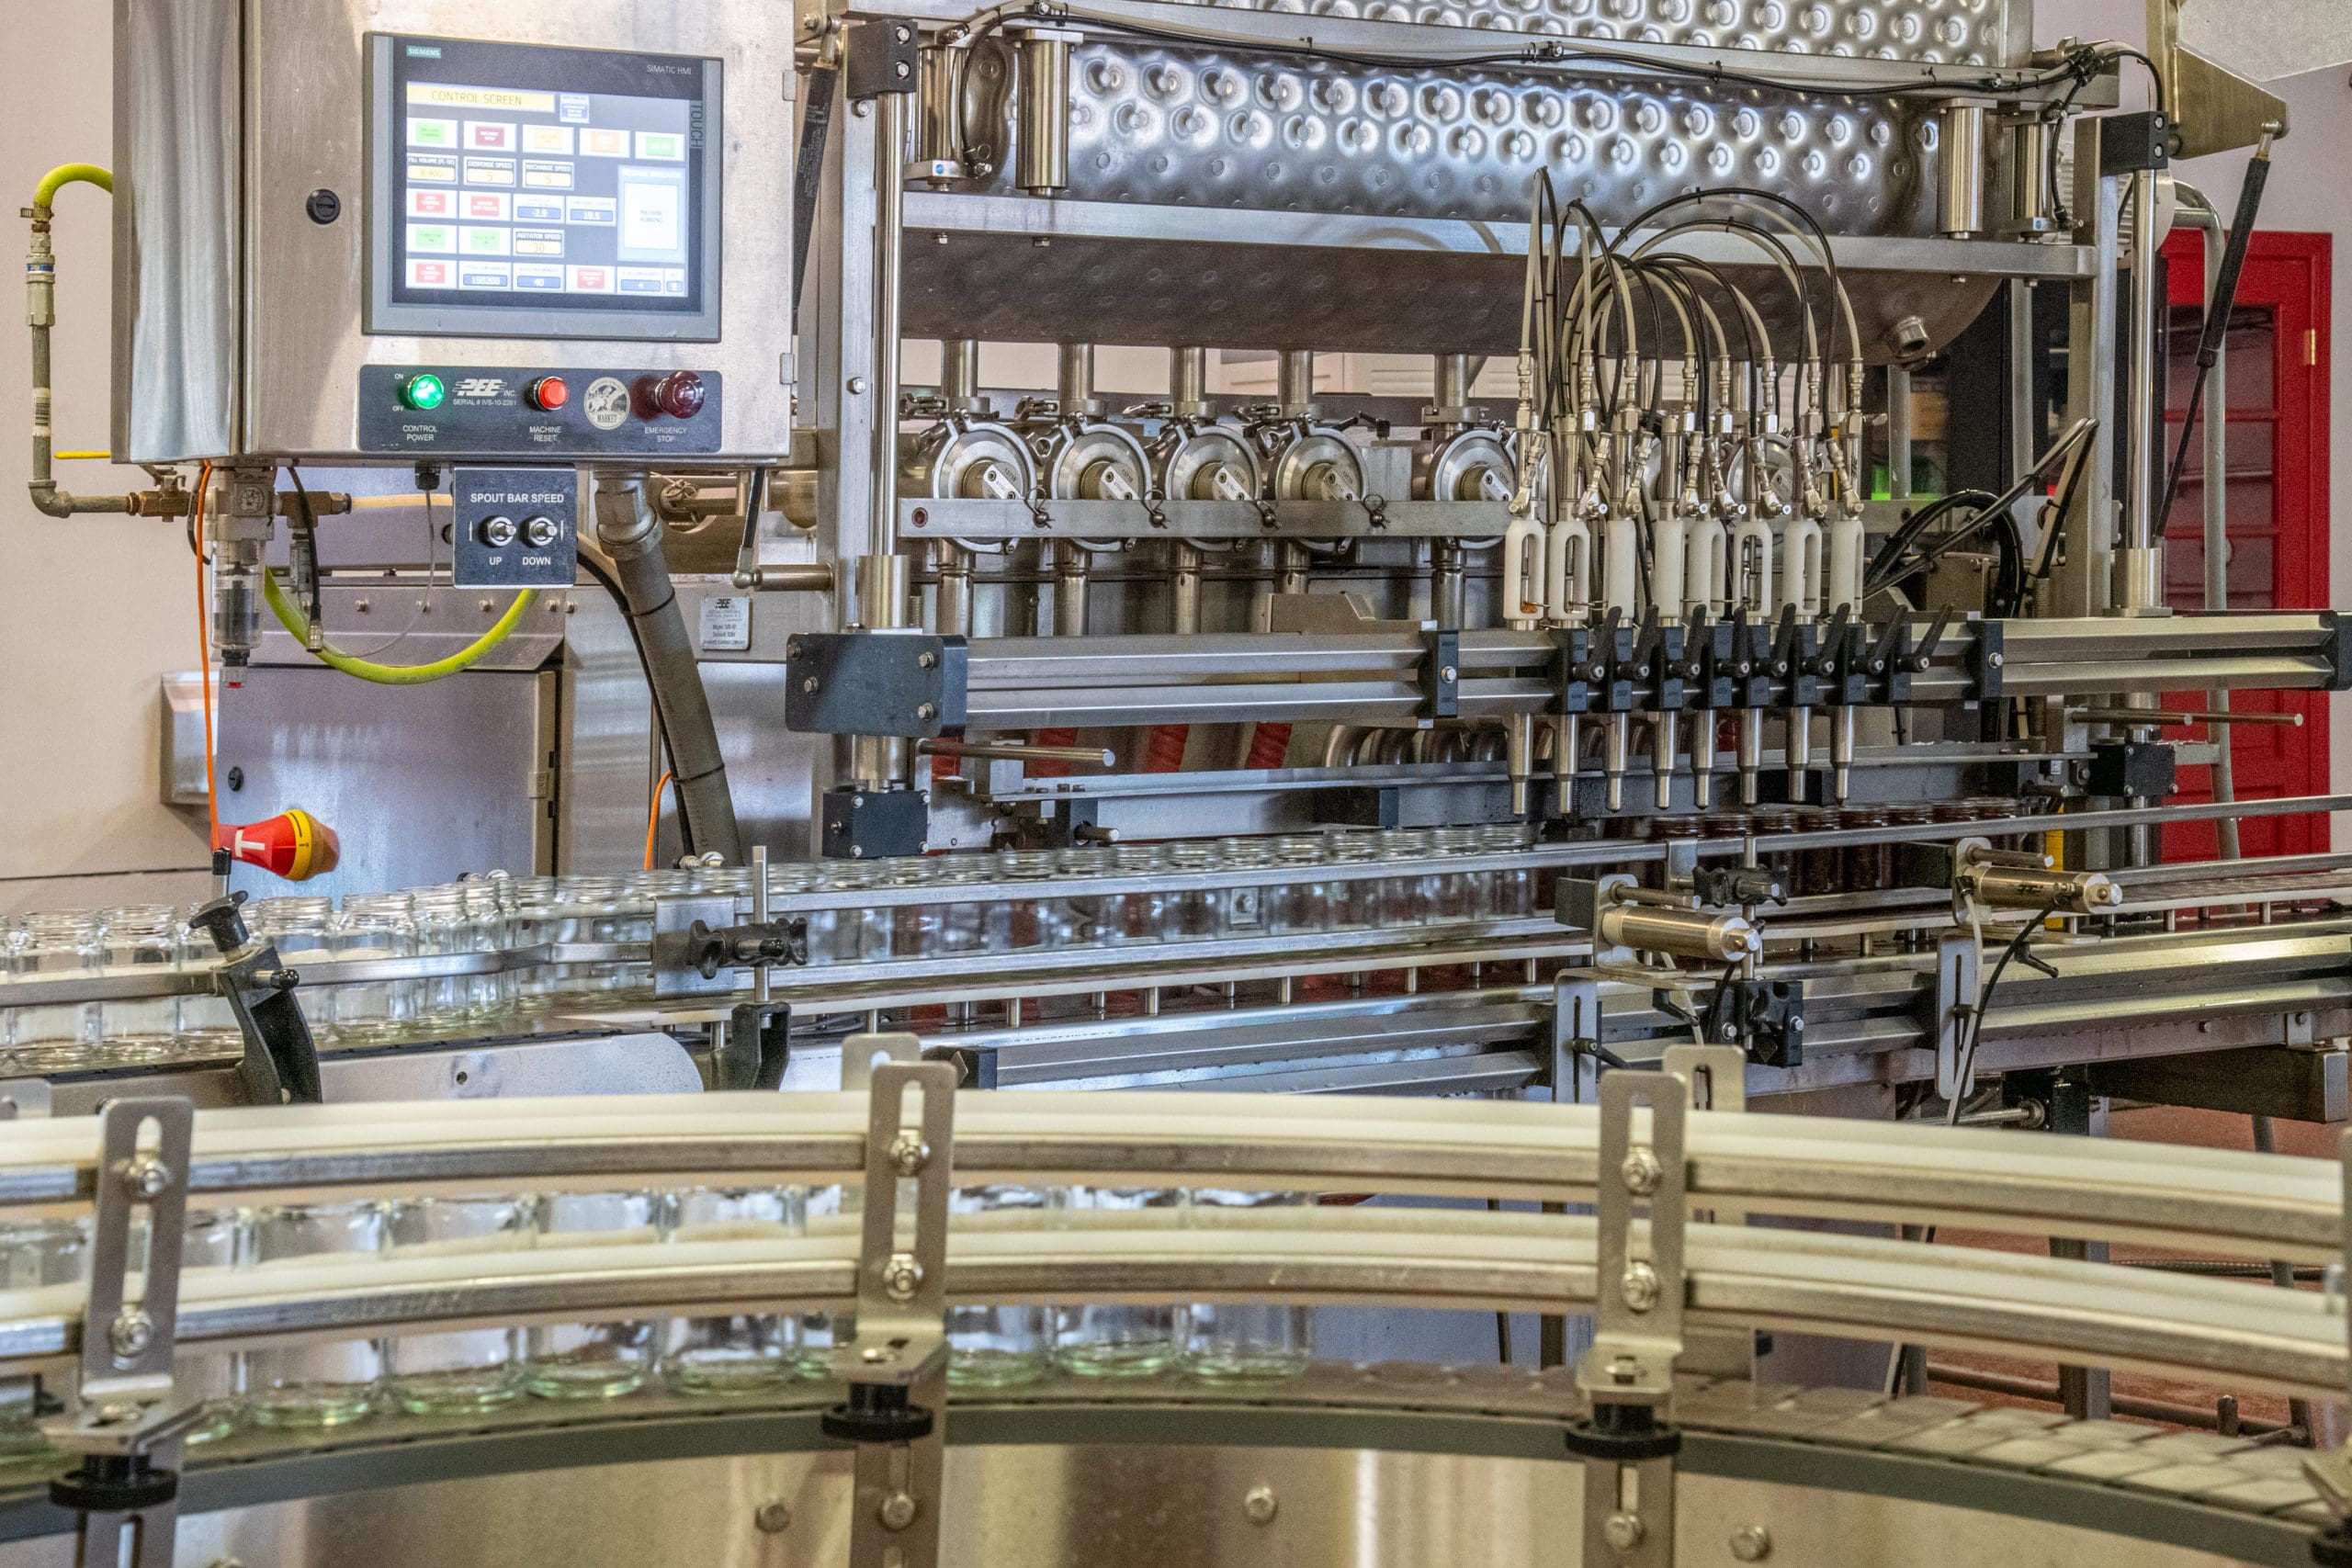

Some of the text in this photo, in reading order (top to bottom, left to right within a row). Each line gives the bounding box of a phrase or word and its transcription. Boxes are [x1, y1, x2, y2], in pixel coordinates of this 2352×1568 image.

[408, 47, 440, 56] SIEMENS
[646, 64, 691, 74] SIMATIC HMI
[432, 90, 522, 106] CONTROL SCREEN
[691, 102, 703, 147] TOUCH
[529, 425, 561, 434] MACHINE
[644, 426, 687, 434] EMERGENCY
[534, 434, 557, 442] RESET
[656, 434, 675, 443] STOP
[470, 493, 564, 503] SPOUT BAR SPEED
[489, 557, 551, 565] UP DOWN
